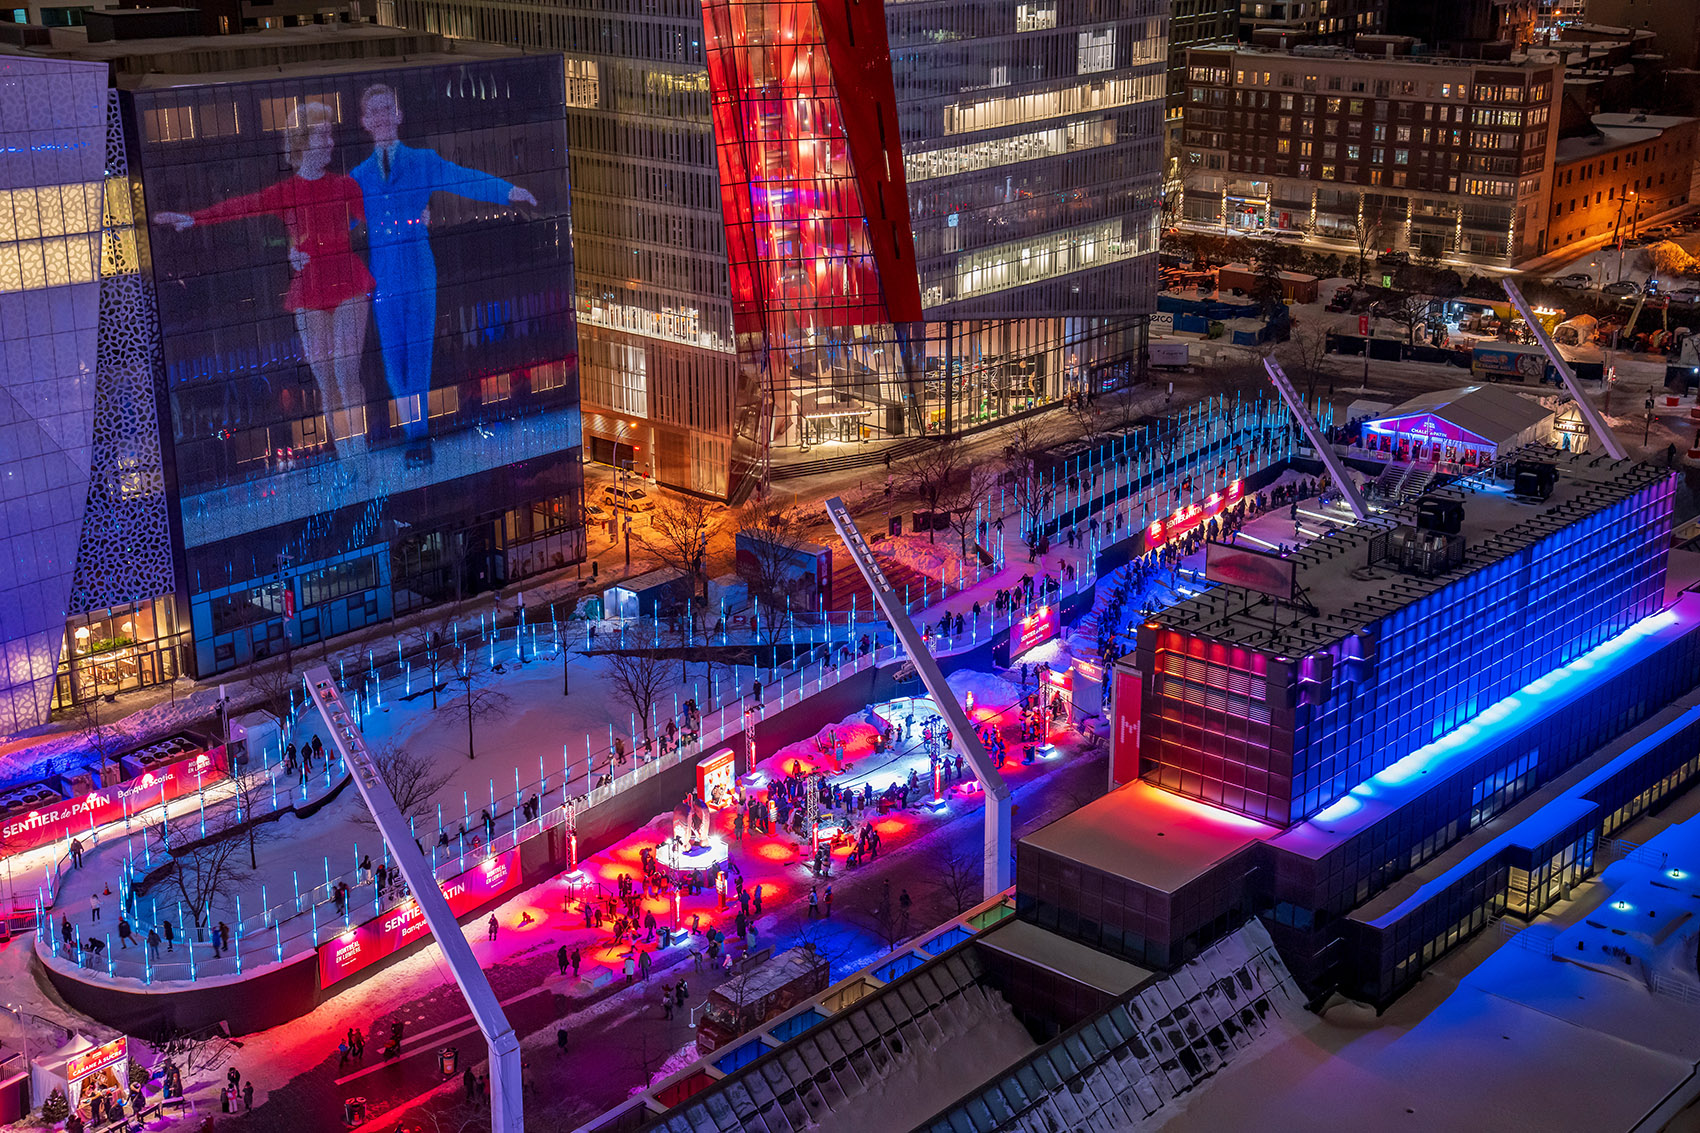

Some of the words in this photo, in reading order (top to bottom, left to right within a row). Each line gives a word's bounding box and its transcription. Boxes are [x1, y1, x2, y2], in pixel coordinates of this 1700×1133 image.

[2, 813, 60, 838] SENTIER
[60, 808, 71, 820] de
[72, 793, 110, 816] PATIN
[443, 882, 465, 900] ATIN
[73, 1062, 96, 1076] CABANE
[103, 1050, 122, 1062] SUCRE
